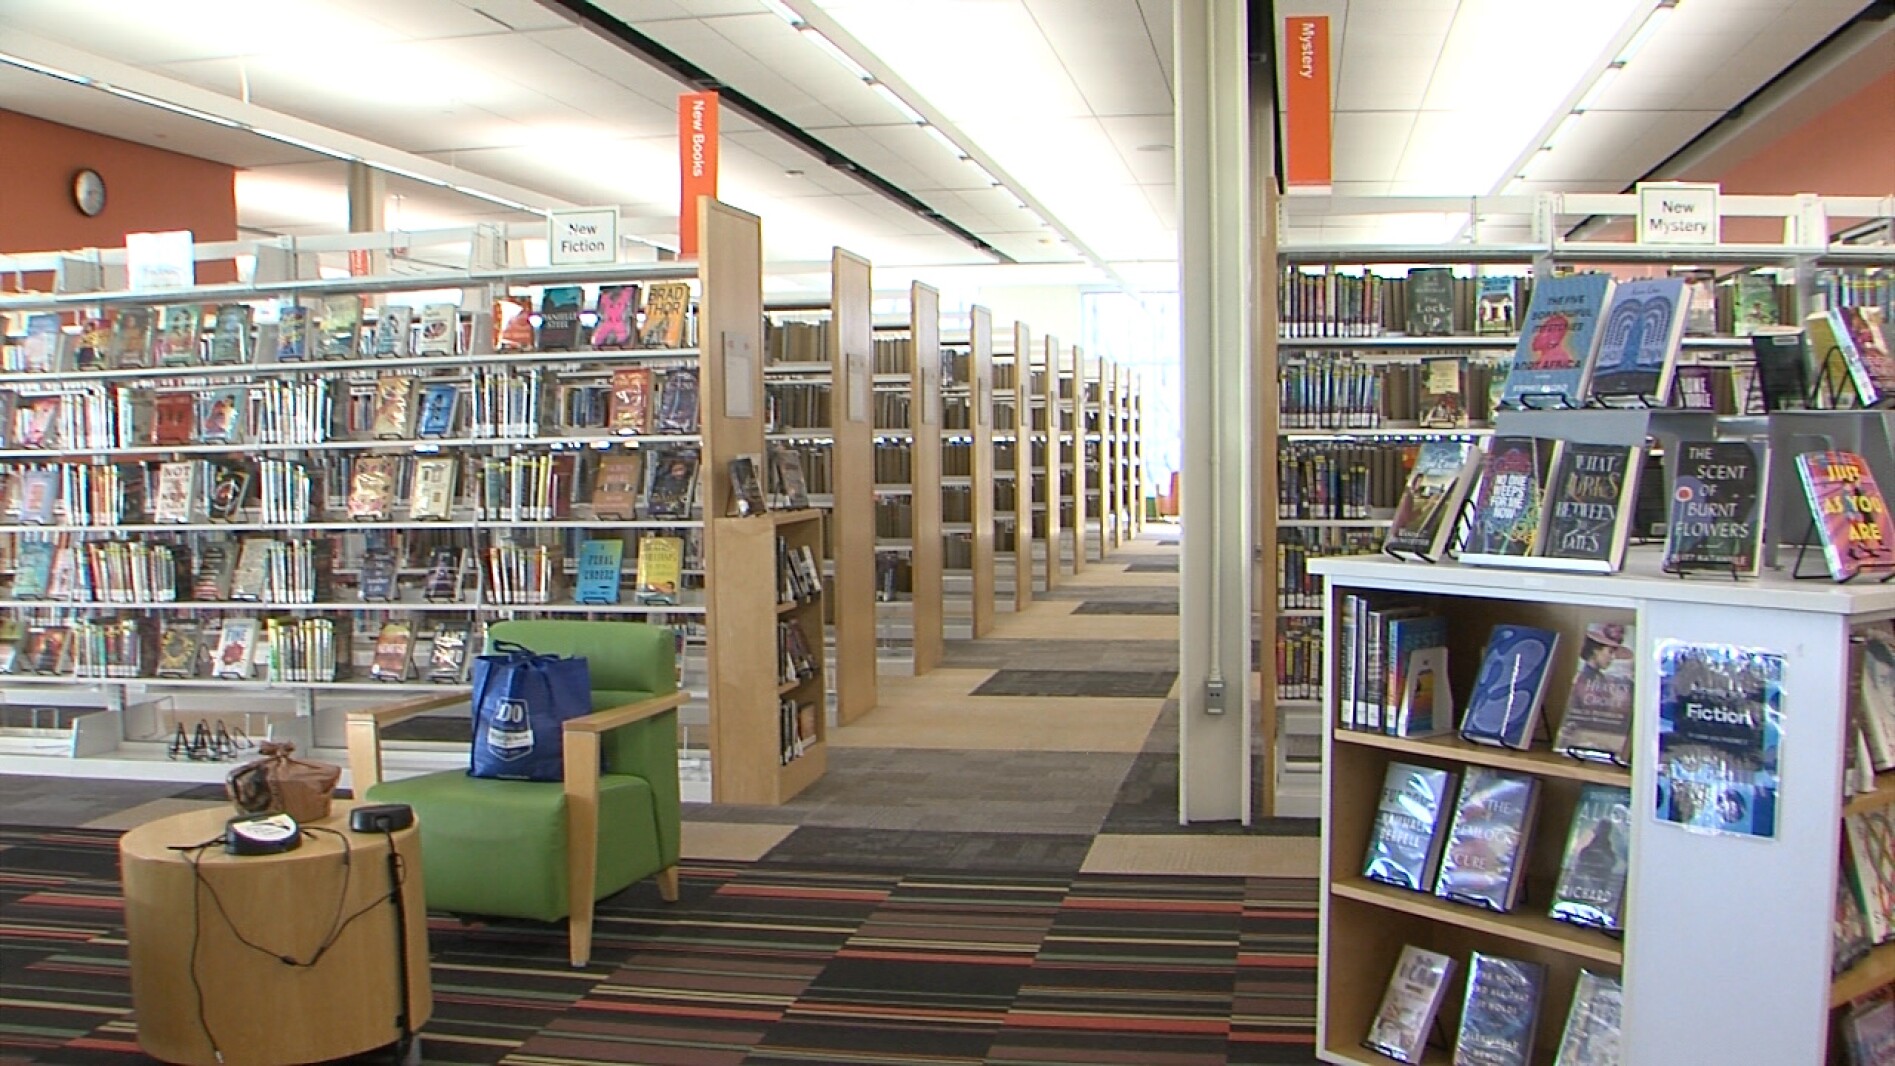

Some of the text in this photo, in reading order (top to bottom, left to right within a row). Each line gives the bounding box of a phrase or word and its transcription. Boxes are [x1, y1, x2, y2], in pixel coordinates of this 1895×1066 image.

[1299, 22, 1315, 79] Mystery
[692, 100, 706, 177] New Books
[1662, 200, 1695, 214] New
[569, 223, 598, 235] New
[1650, 218, 1708, 235] Mystery
[561, 239, 605, 253] Fiction
[650, 286, 683, 301] BRAD
[1689, 447, 1713, 460] THE
[1575, 455, 1616, 472] WHAT
[1697, 465, 1748, 480] SCENT
[1699, 483, 1717, 497] OF
[1687, 502, 1738, 518] BURNT
[1823, 494, 1883, 514] AS YOU
[1675, 522, 1750, 539] FLOWERS
[1848, 522, 1883, 541] ARE
[1686, 702, 1752, 725] Fiction
[1487, 800, 1513, 815] THE
